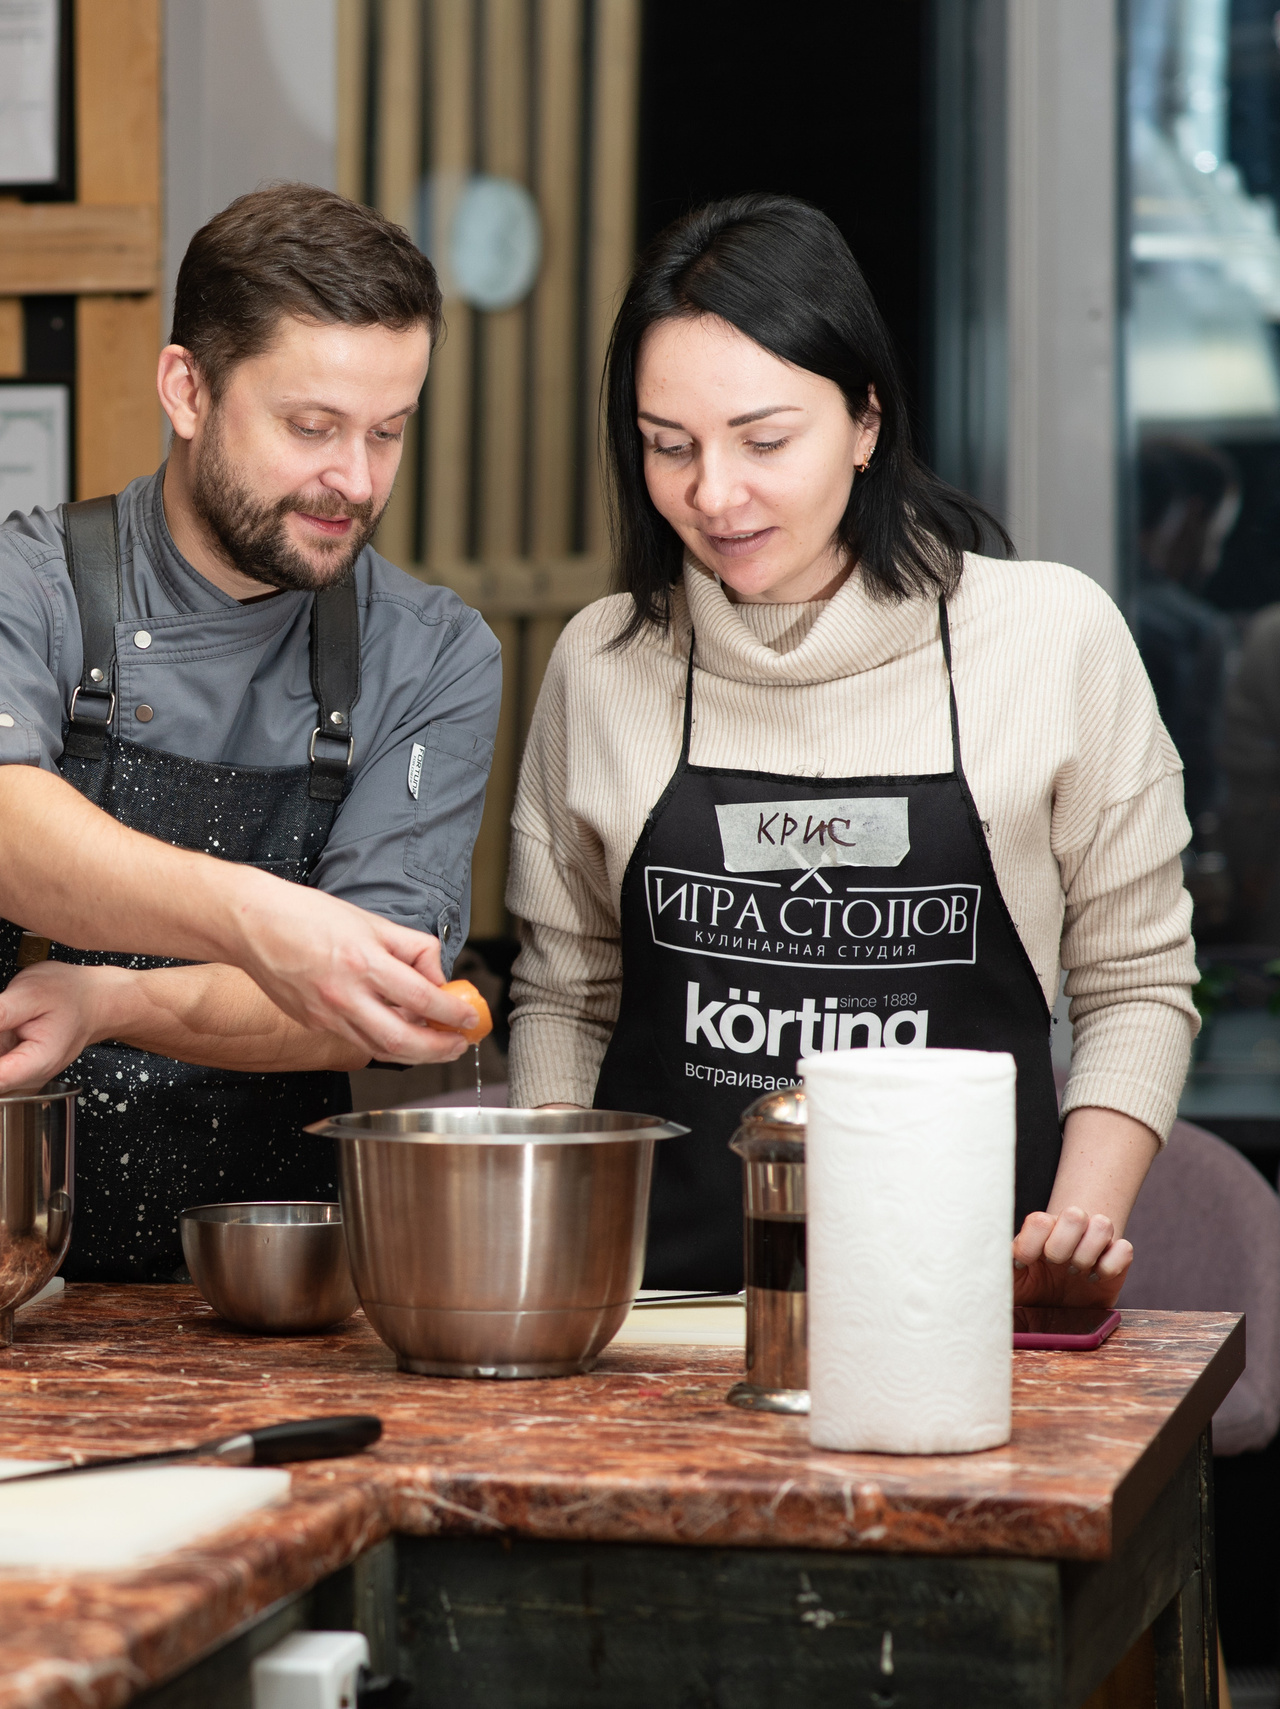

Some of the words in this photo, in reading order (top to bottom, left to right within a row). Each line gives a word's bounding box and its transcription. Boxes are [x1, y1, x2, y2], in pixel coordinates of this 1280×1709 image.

[756, 812, 857, 847] КРИС
[655, 877, 767, 933] ИГРА
[779, 895, 968, 939] СТОЛОВ
[694, 930, 827, 957] КУЛИНАРНАЯ
[838, 943, 918, 960] СТУДИЯ
[839, 994, 877, 1009] since
[882, 992, 918, 1008] 1889
